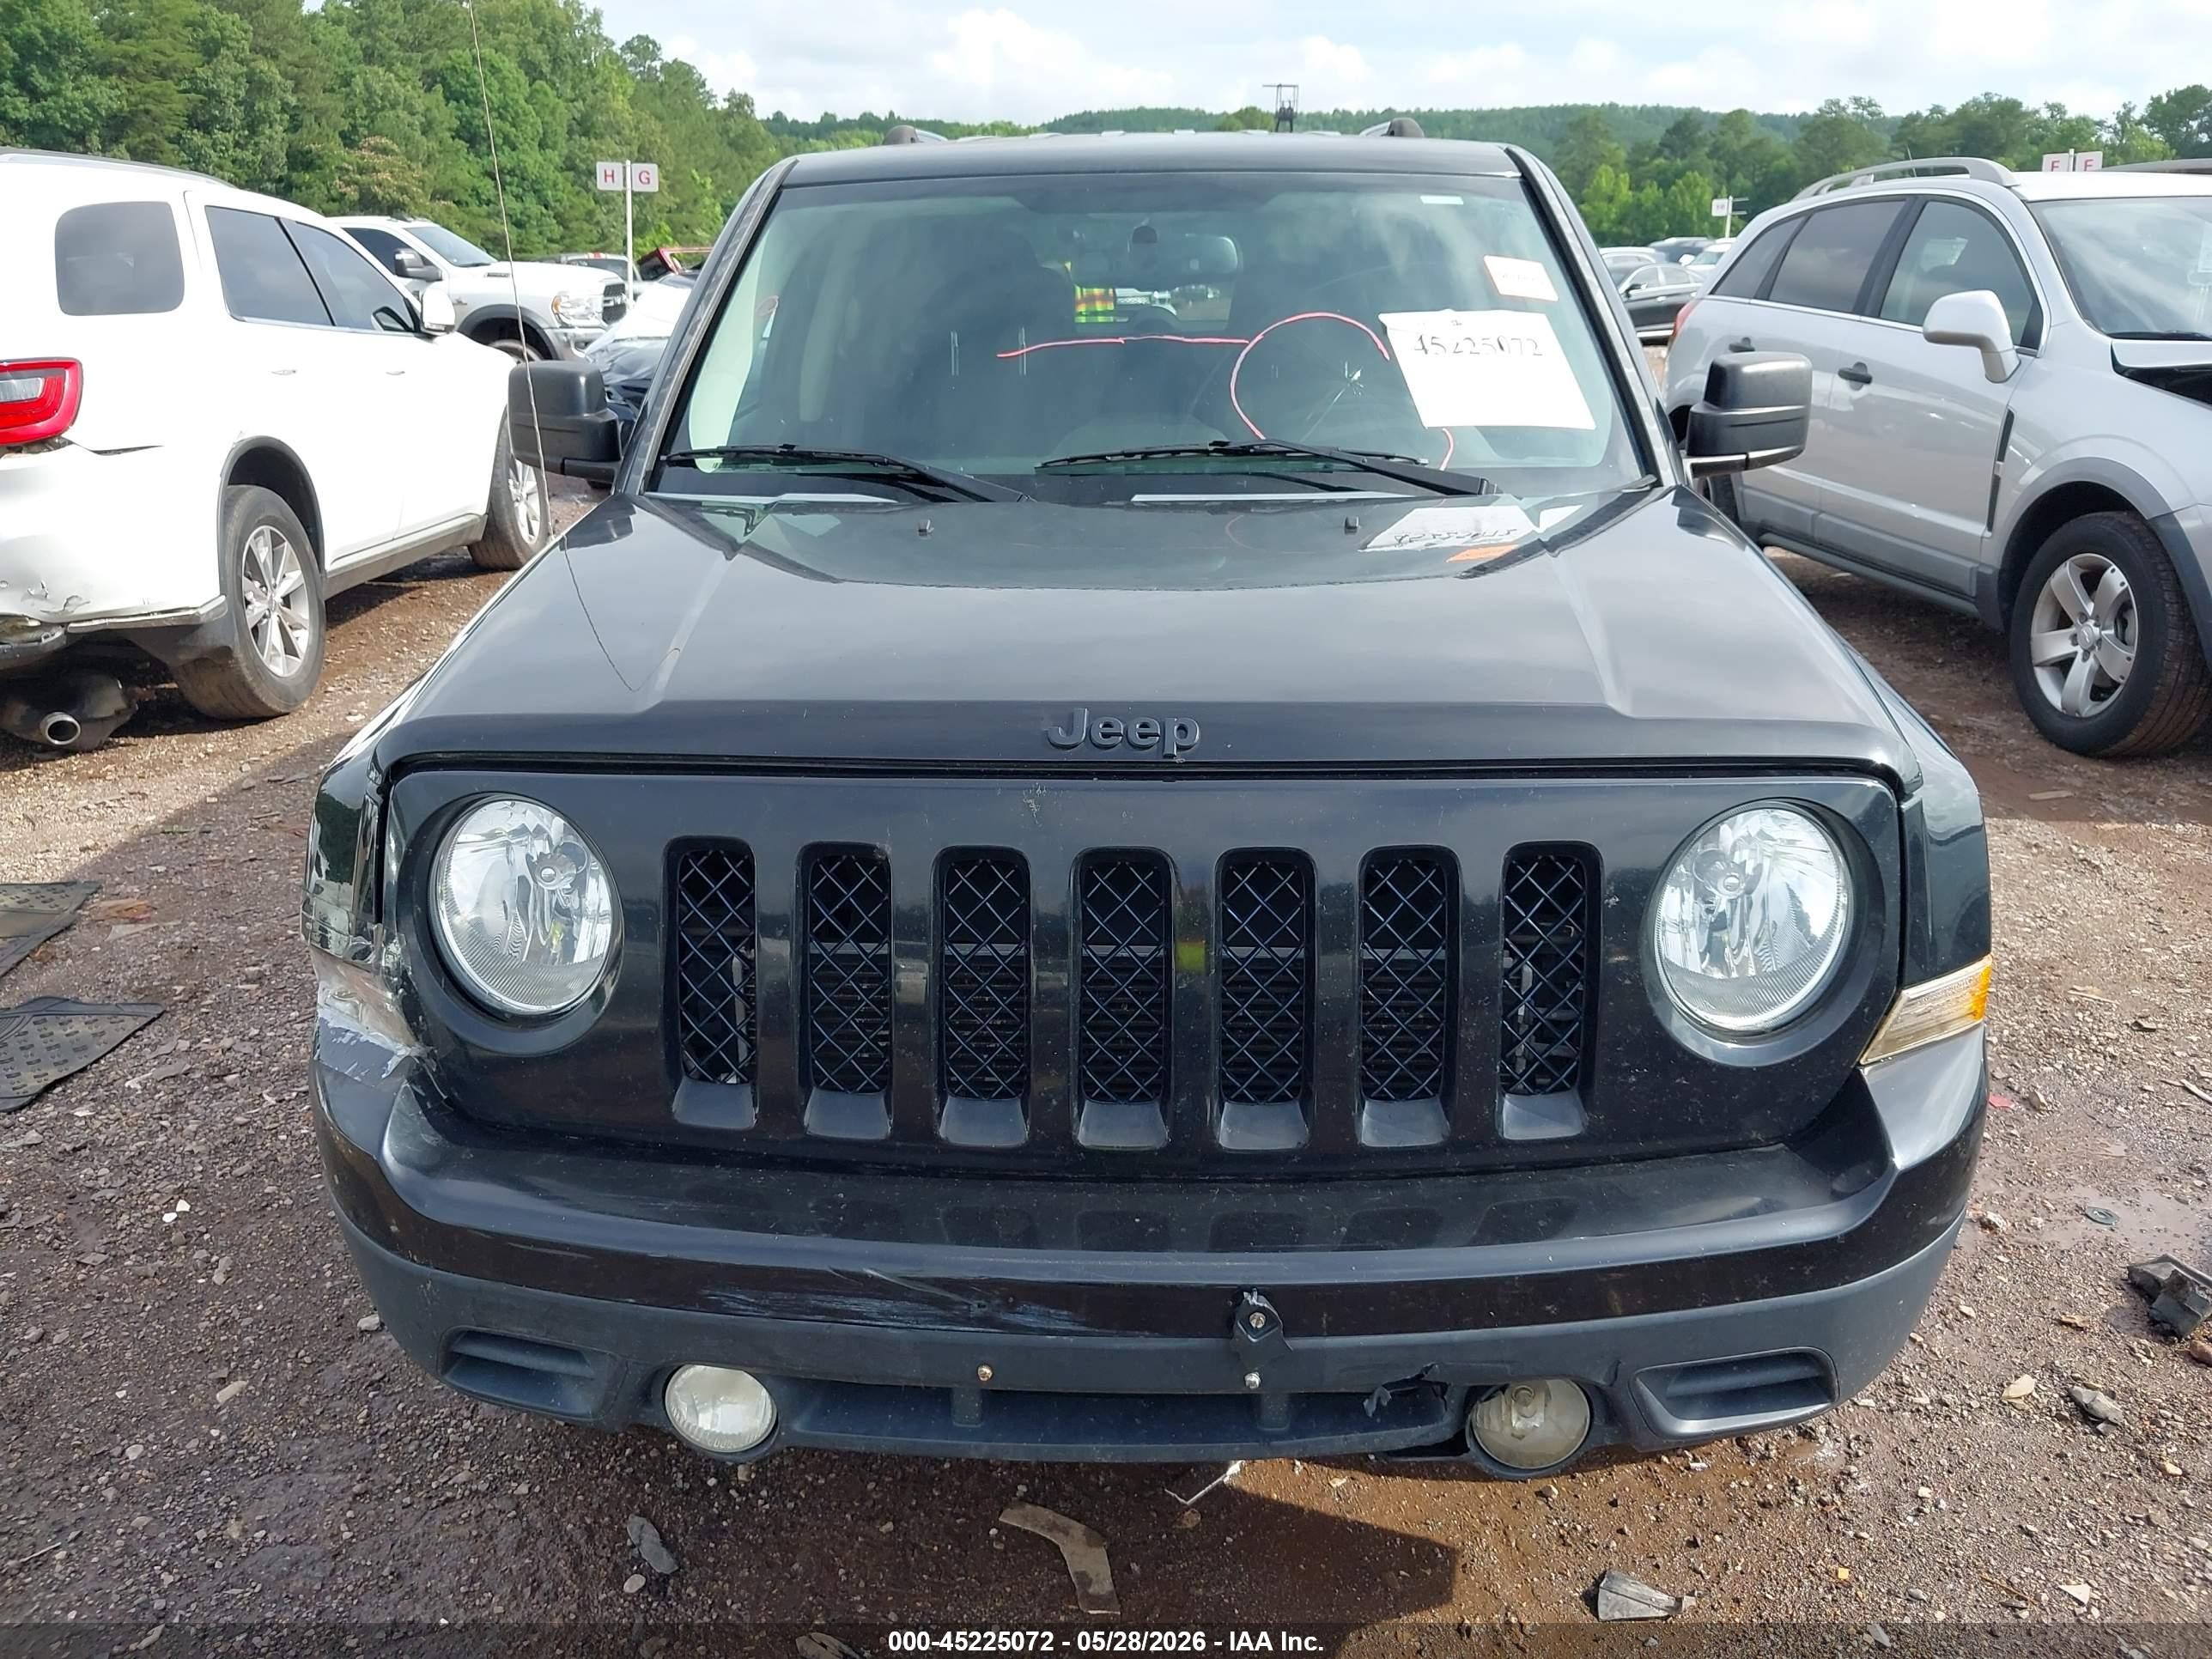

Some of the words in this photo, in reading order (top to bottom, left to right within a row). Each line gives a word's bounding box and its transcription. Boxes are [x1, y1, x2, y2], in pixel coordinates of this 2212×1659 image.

[604, 169, 615, 184] H
[638, 170, 651, 185] G
[1045, 708, 1200, 758] Jeep
